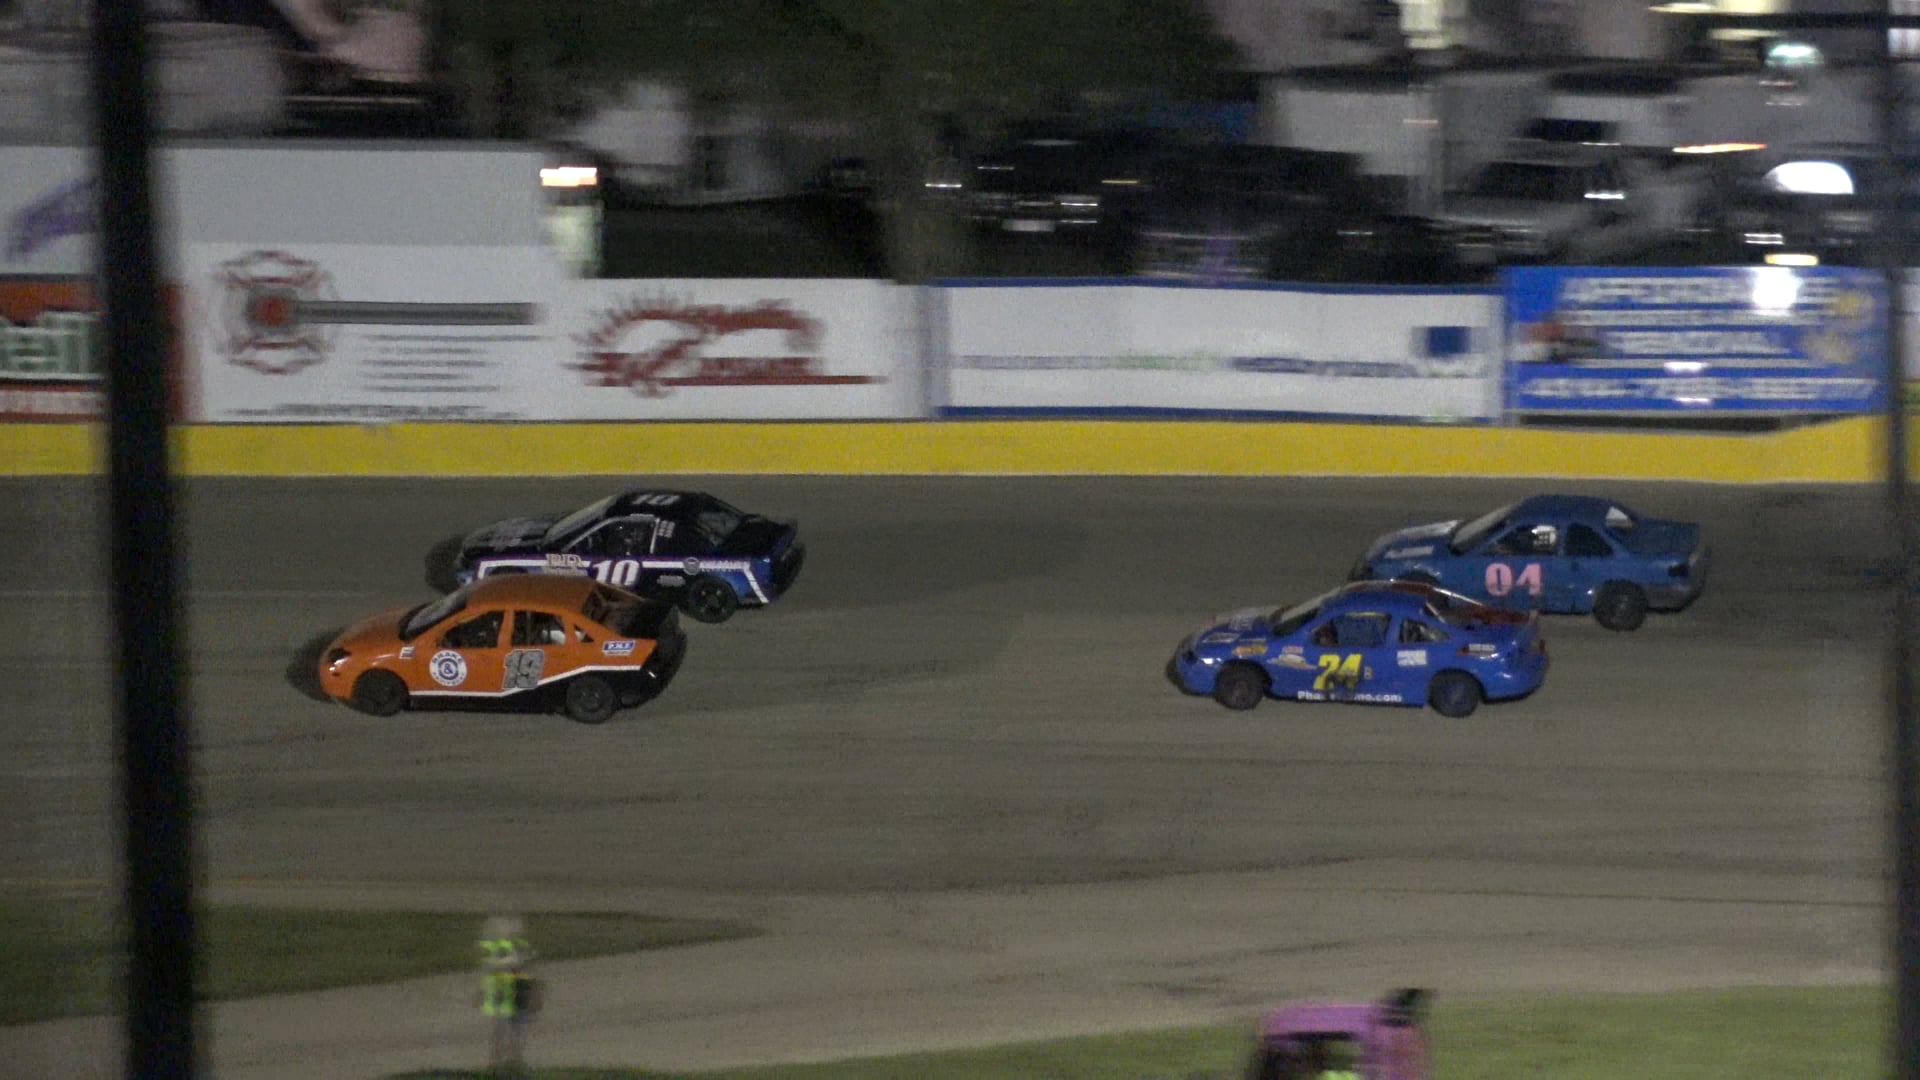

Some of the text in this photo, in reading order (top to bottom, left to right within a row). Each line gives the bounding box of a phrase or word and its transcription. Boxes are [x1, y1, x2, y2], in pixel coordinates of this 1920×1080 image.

[592, 559, 640, 586] 10
[1485, 563, 1541, 596] 04
[503, 649, 545, 690] 19
[1312, 653, 1362, 690] 24
